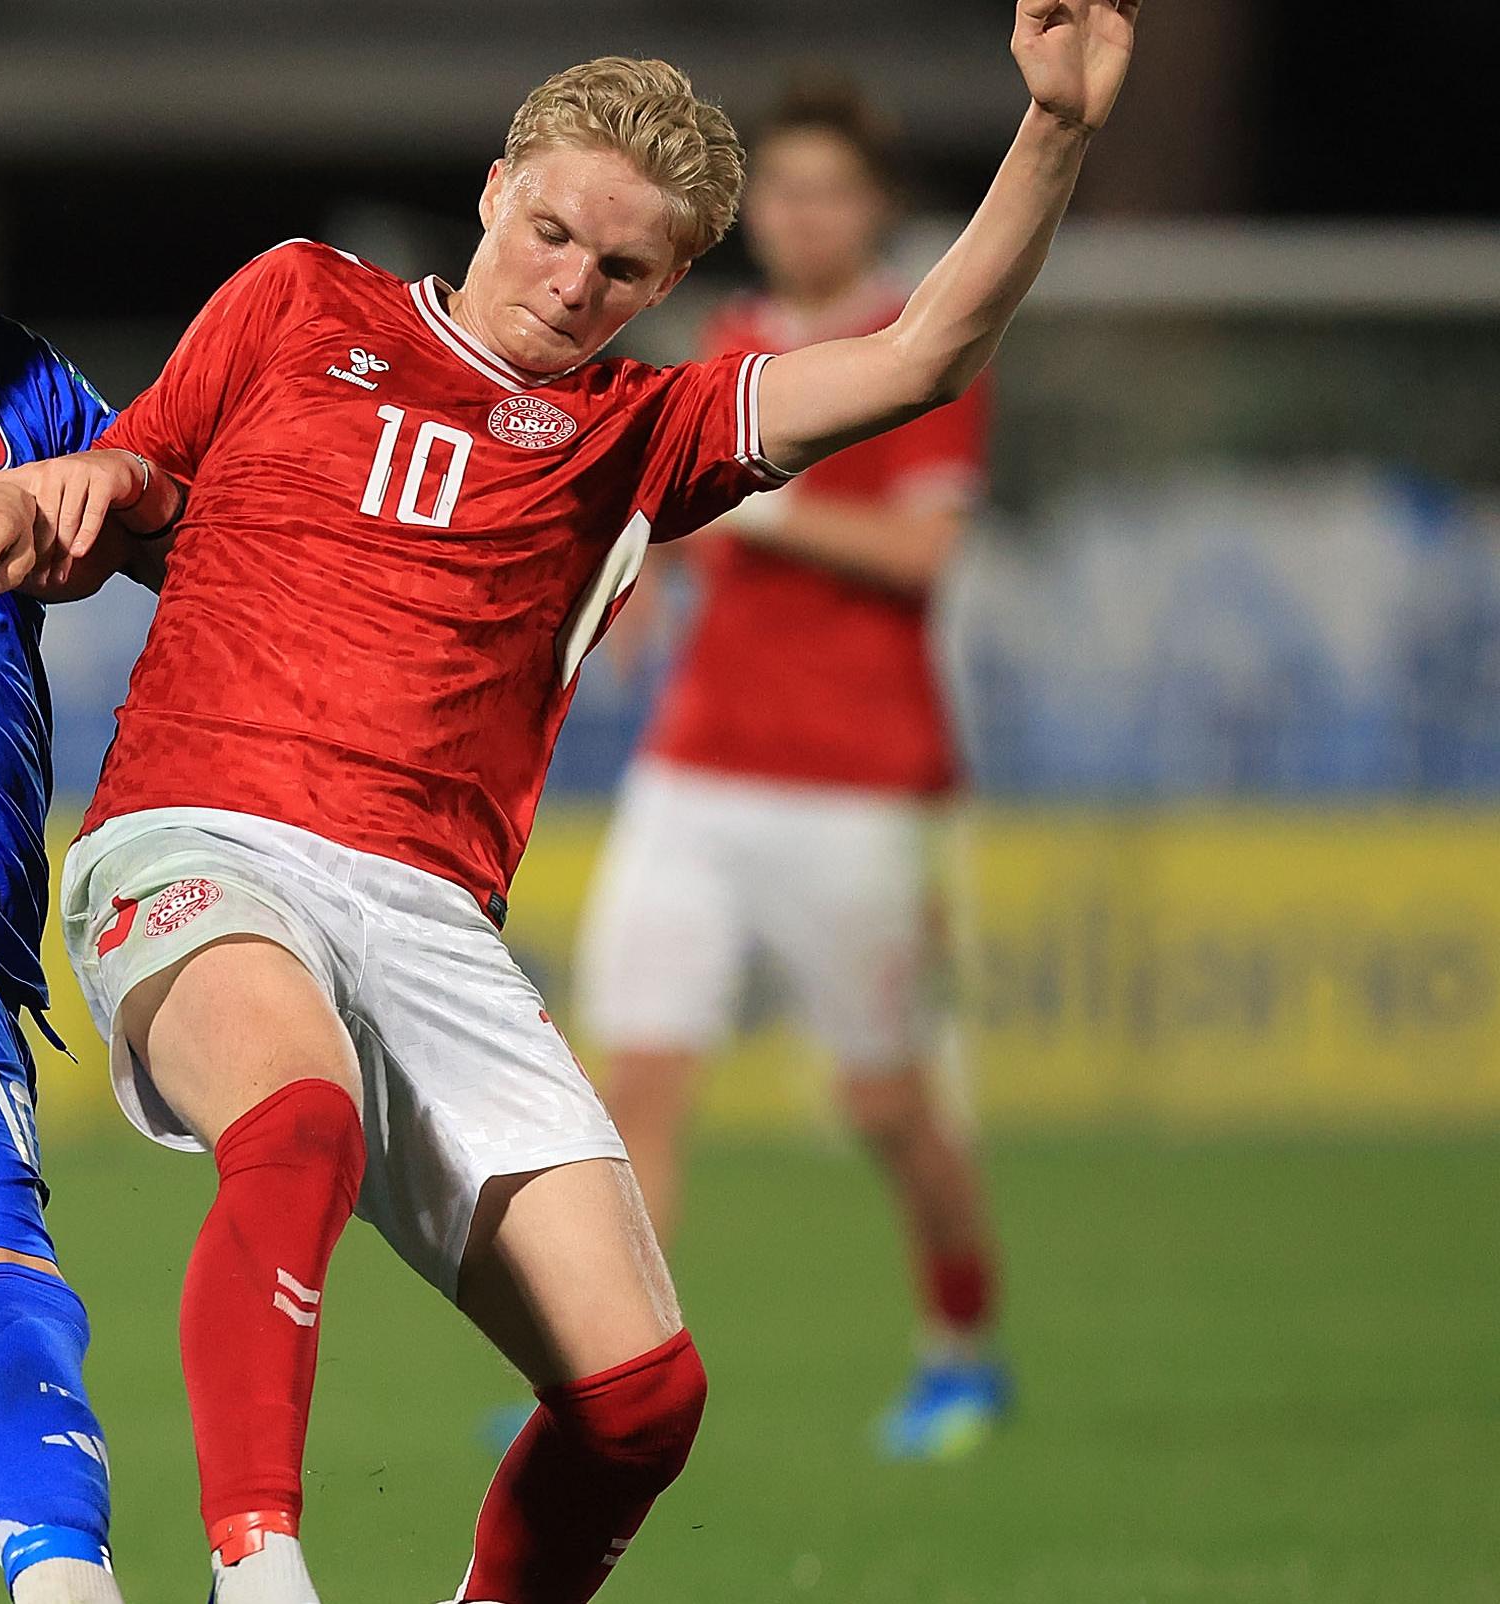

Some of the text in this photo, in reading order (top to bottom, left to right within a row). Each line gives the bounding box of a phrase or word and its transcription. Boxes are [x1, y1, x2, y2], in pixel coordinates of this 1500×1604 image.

[326, 365, 378, 391] hummel
[506, 415, 558, 433] DBU
[359, 404, 474, 528] 10
[157, 887, 206, 926] DBU
